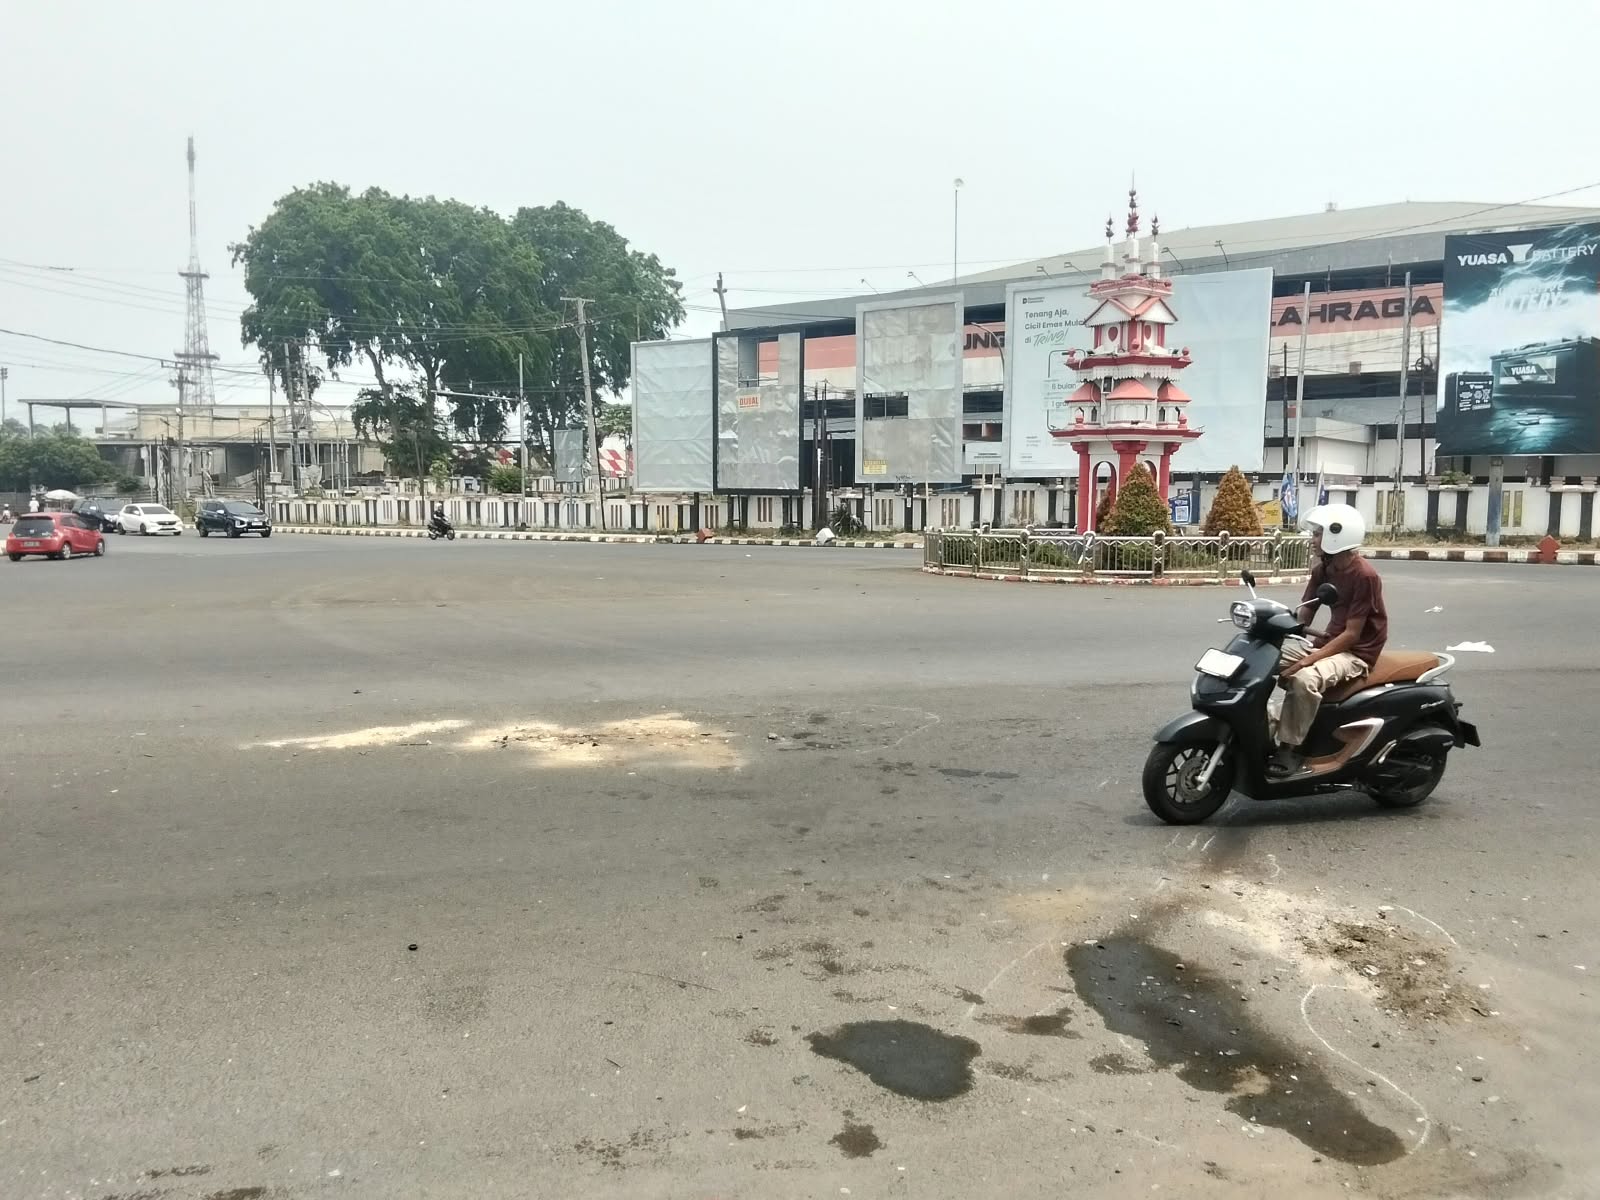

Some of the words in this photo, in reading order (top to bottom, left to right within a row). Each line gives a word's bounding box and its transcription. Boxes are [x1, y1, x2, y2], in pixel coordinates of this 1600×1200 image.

[1457, 252, 1508, 267] YUASA
[1532, 243, 1598, 261] BATTERY
[1025, 310, 1053, 319] Tenang
[1054, 308, 1069, 318] Aja,
[1271, 295, 1436, 327] AHRAGA
[1024, 322, 1041, 330] Cicil
[1042, 321, 1063, 329] Emas
[1510, 365, 1537, 376] YUASA
[1057, 382, 1077, 390] bulan
